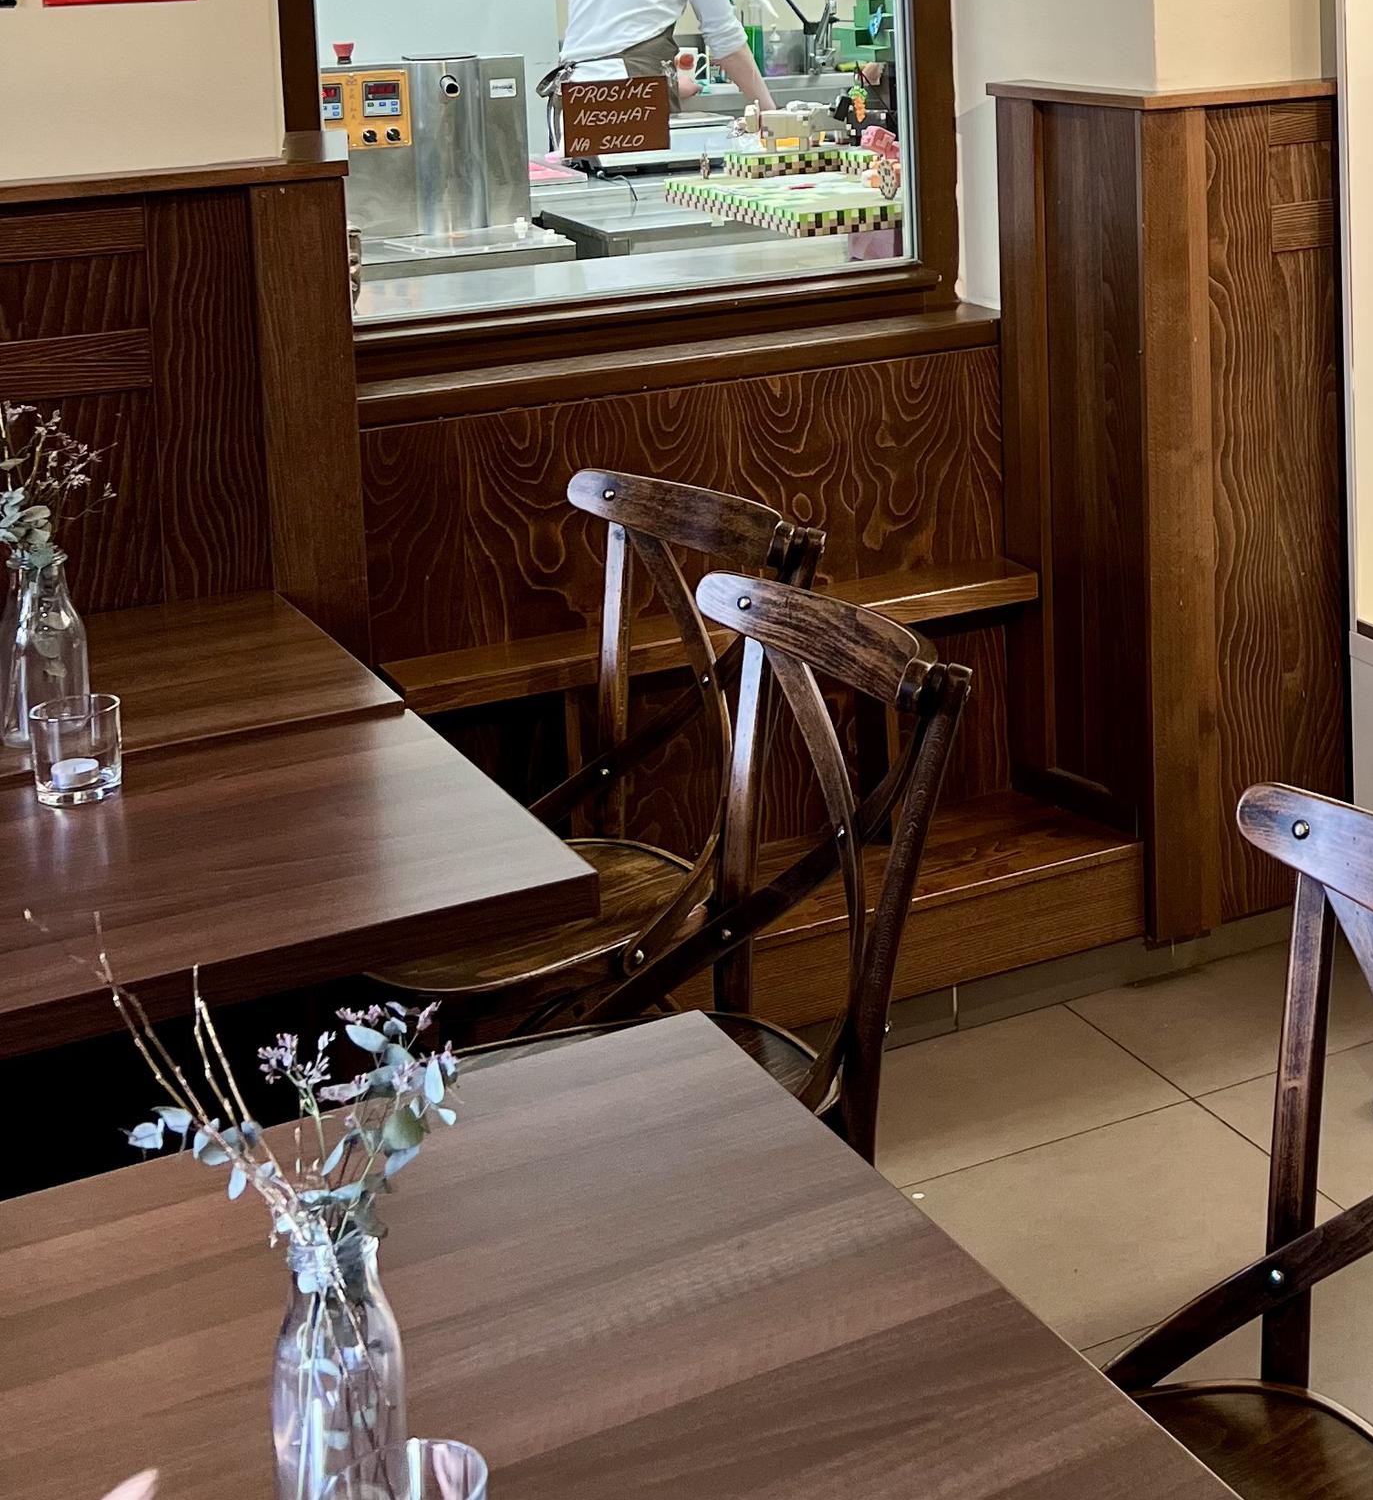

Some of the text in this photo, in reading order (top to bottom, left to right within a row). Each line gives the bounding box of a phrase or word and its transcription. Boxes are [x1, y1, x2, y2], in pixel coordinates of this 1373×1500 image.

[568, 78, 659, 104] PROSÍME
[573, 106, 657, 126] NESAHAT
[570, 134, 644, 152] NA SKLO
